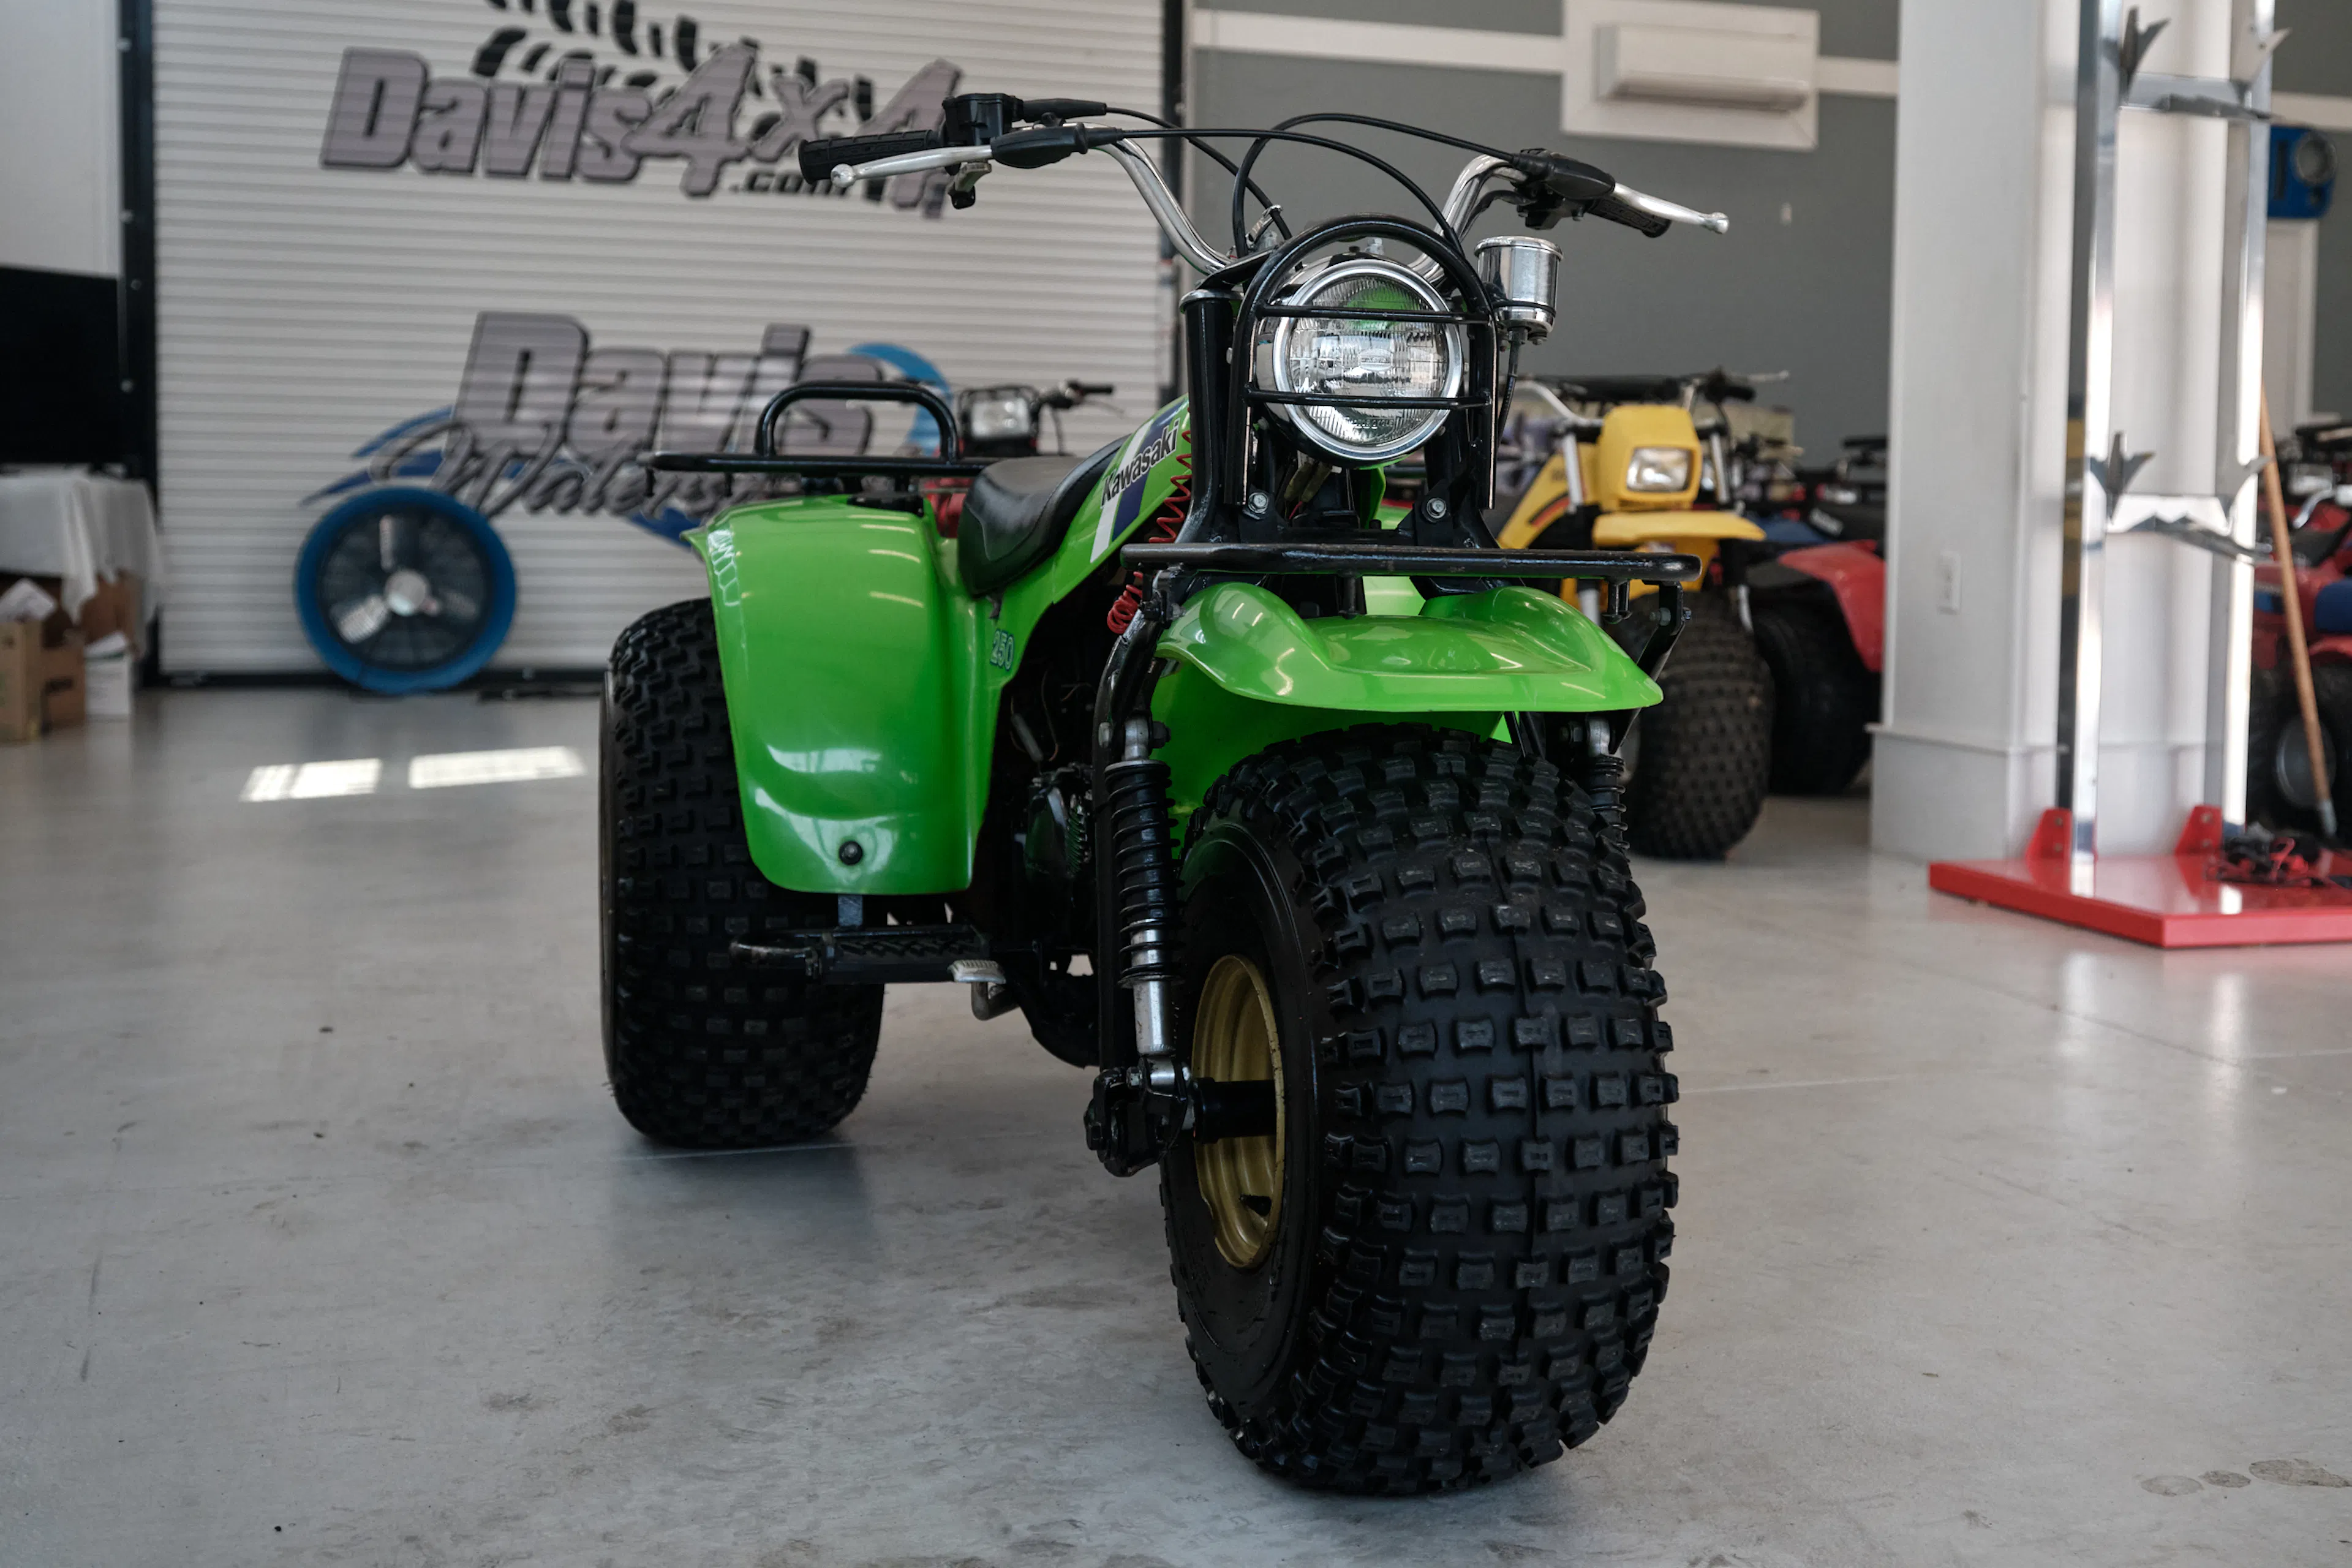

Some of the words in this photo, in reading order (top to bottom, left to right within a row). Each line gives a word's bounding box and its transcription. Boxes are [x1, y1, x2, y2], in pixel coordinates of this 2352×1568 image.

[446, 311, 883, 454] Davis
[1100, 418, 1180, 509] Kawasaki
[990, 628, 1014, 671] 250
